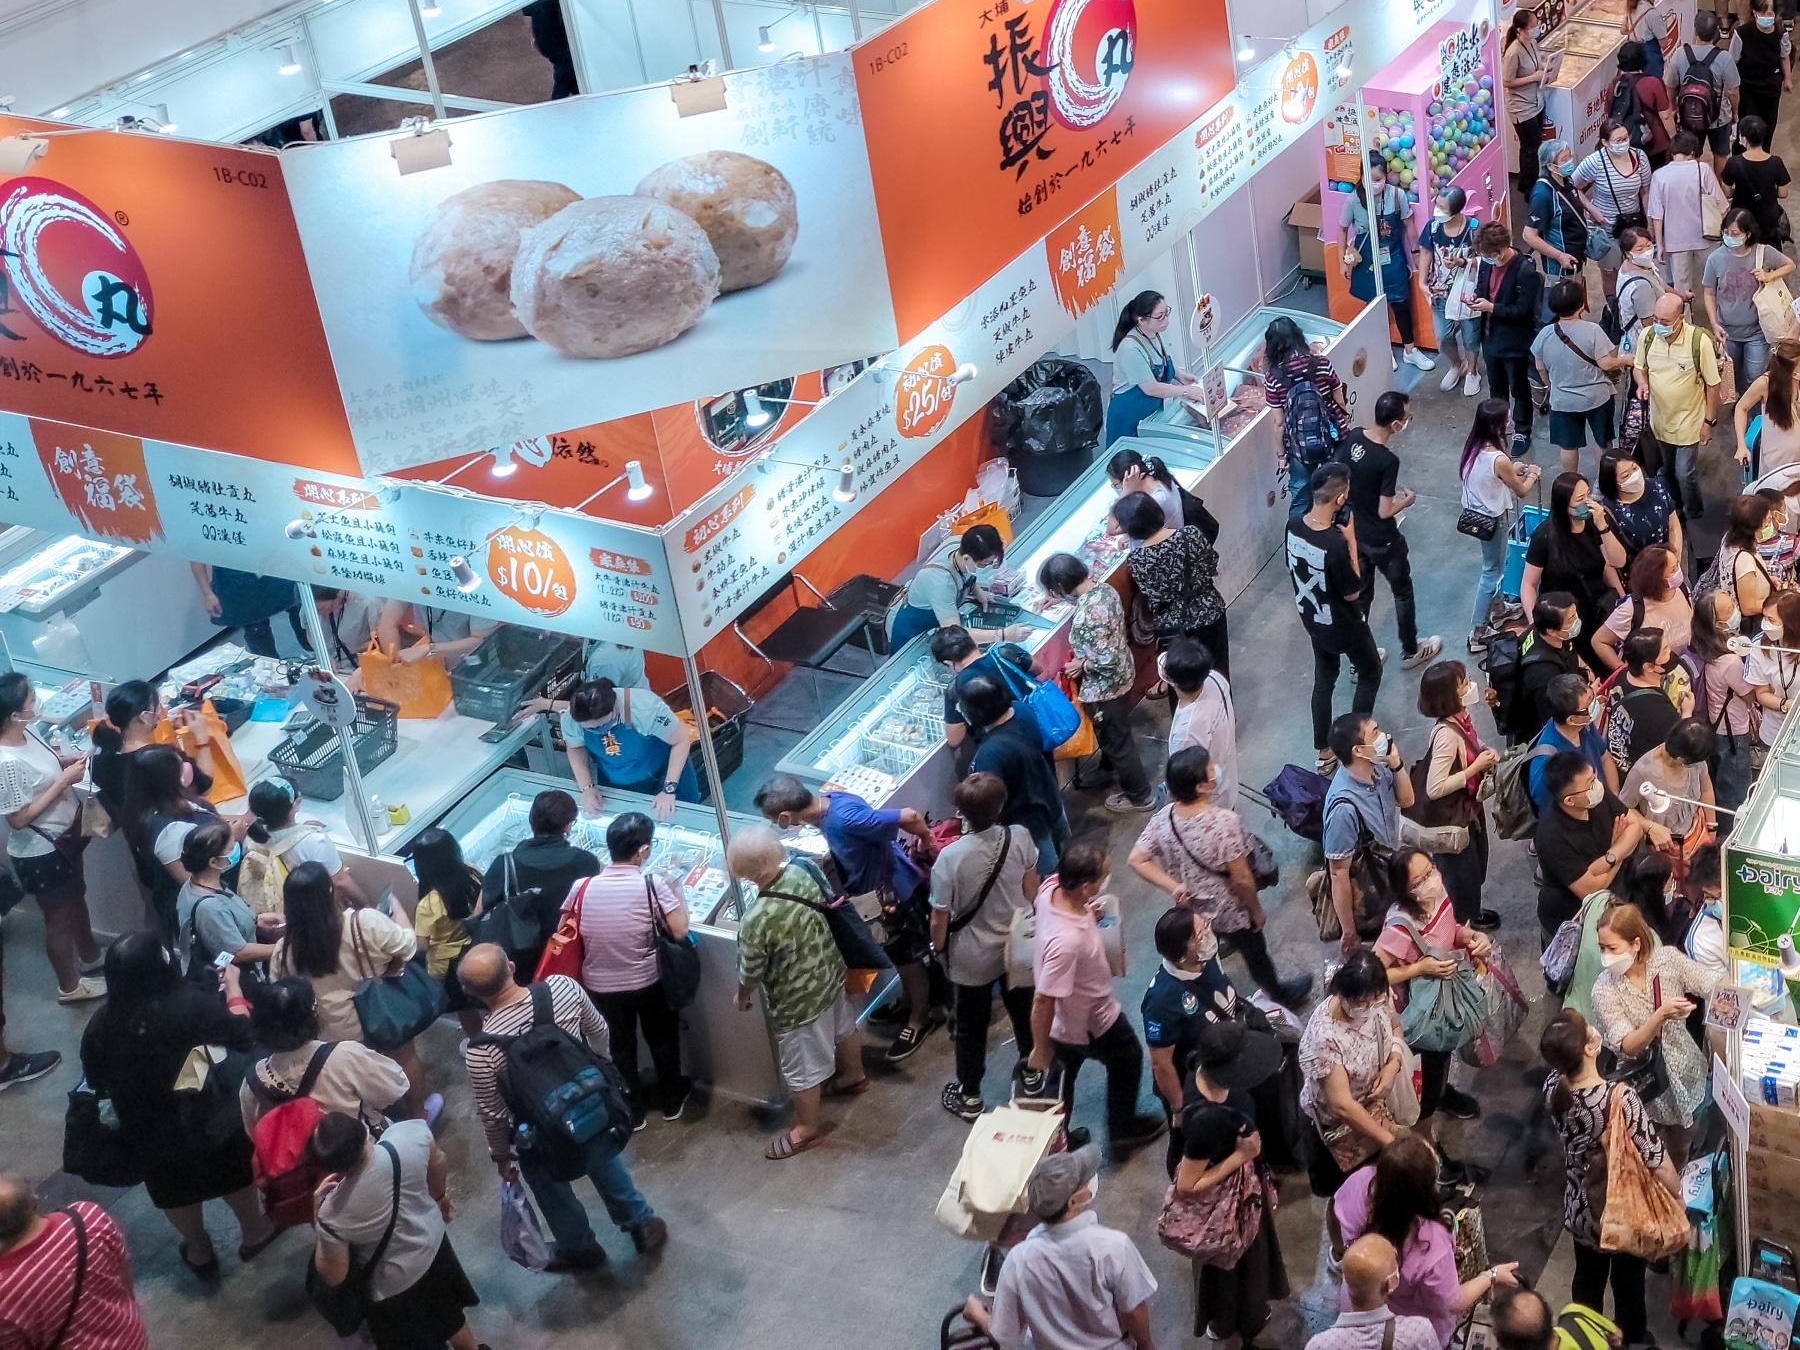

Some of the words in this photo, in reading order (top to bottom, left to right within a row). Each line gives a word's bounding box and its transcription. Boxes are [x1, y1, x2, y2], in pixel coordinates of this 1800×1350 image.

[868, 40, 910, 77] 1B-C02
[212, 165, 270, 191] 1B-C02
[1016, 114, 1137, 217] 始創於一九六七年
[53, 442, 106, 482] 創意
[84, 472, 146, 513] 福袋
[496, 557, 570, 602] $10/包
[1747, 1298, 1785, 1322] Dairy
